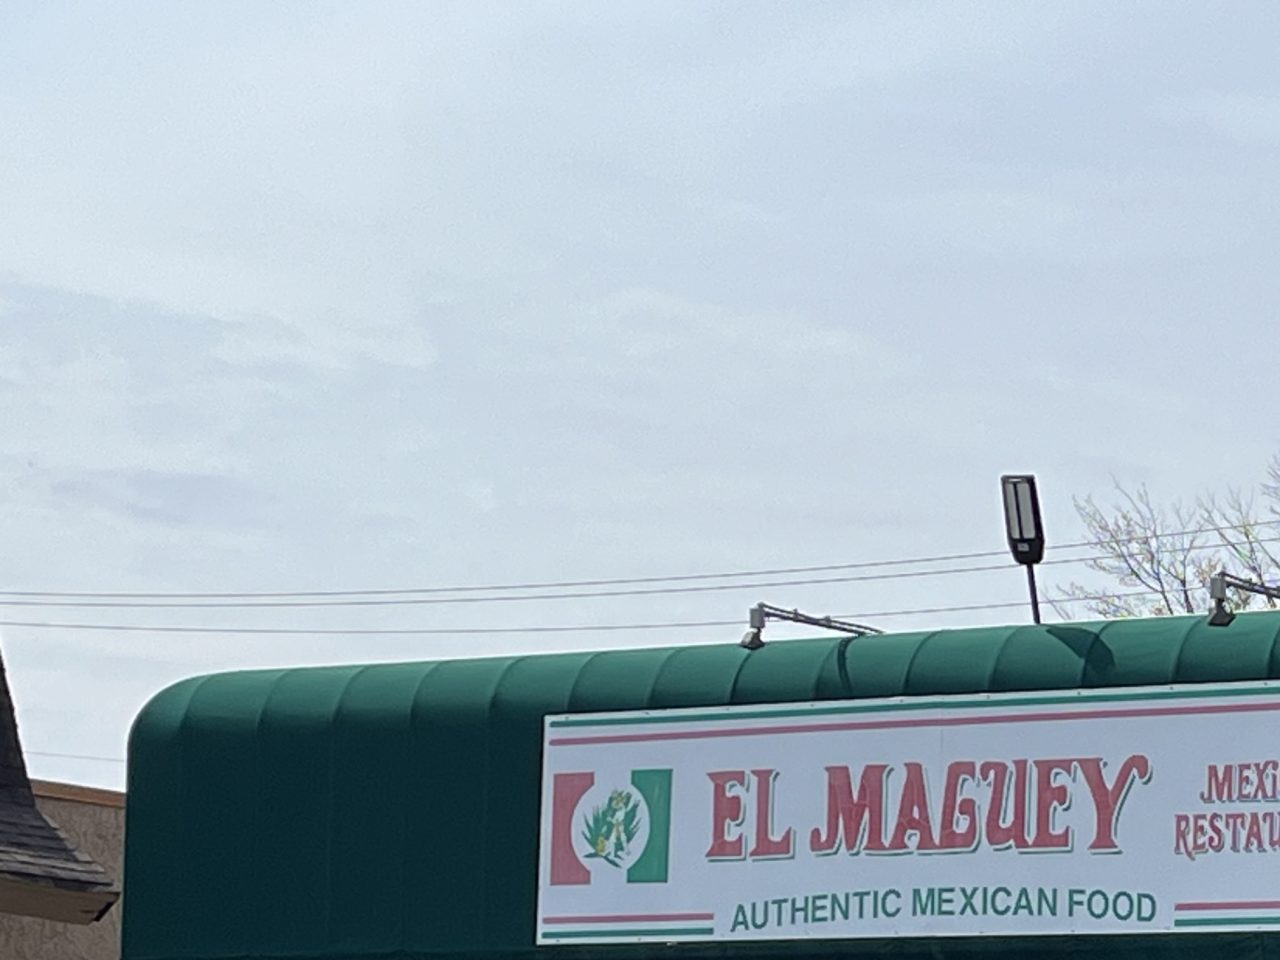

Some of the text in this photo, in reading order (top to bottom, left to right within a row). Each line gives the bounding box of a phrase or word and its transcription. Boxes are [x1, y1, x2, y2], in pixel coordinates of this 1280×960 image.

[705, 754, 1153, 862] EL MAGUEY
[730, 886, 1158, 933] AUTHENTIC MEXICAN FOOD
